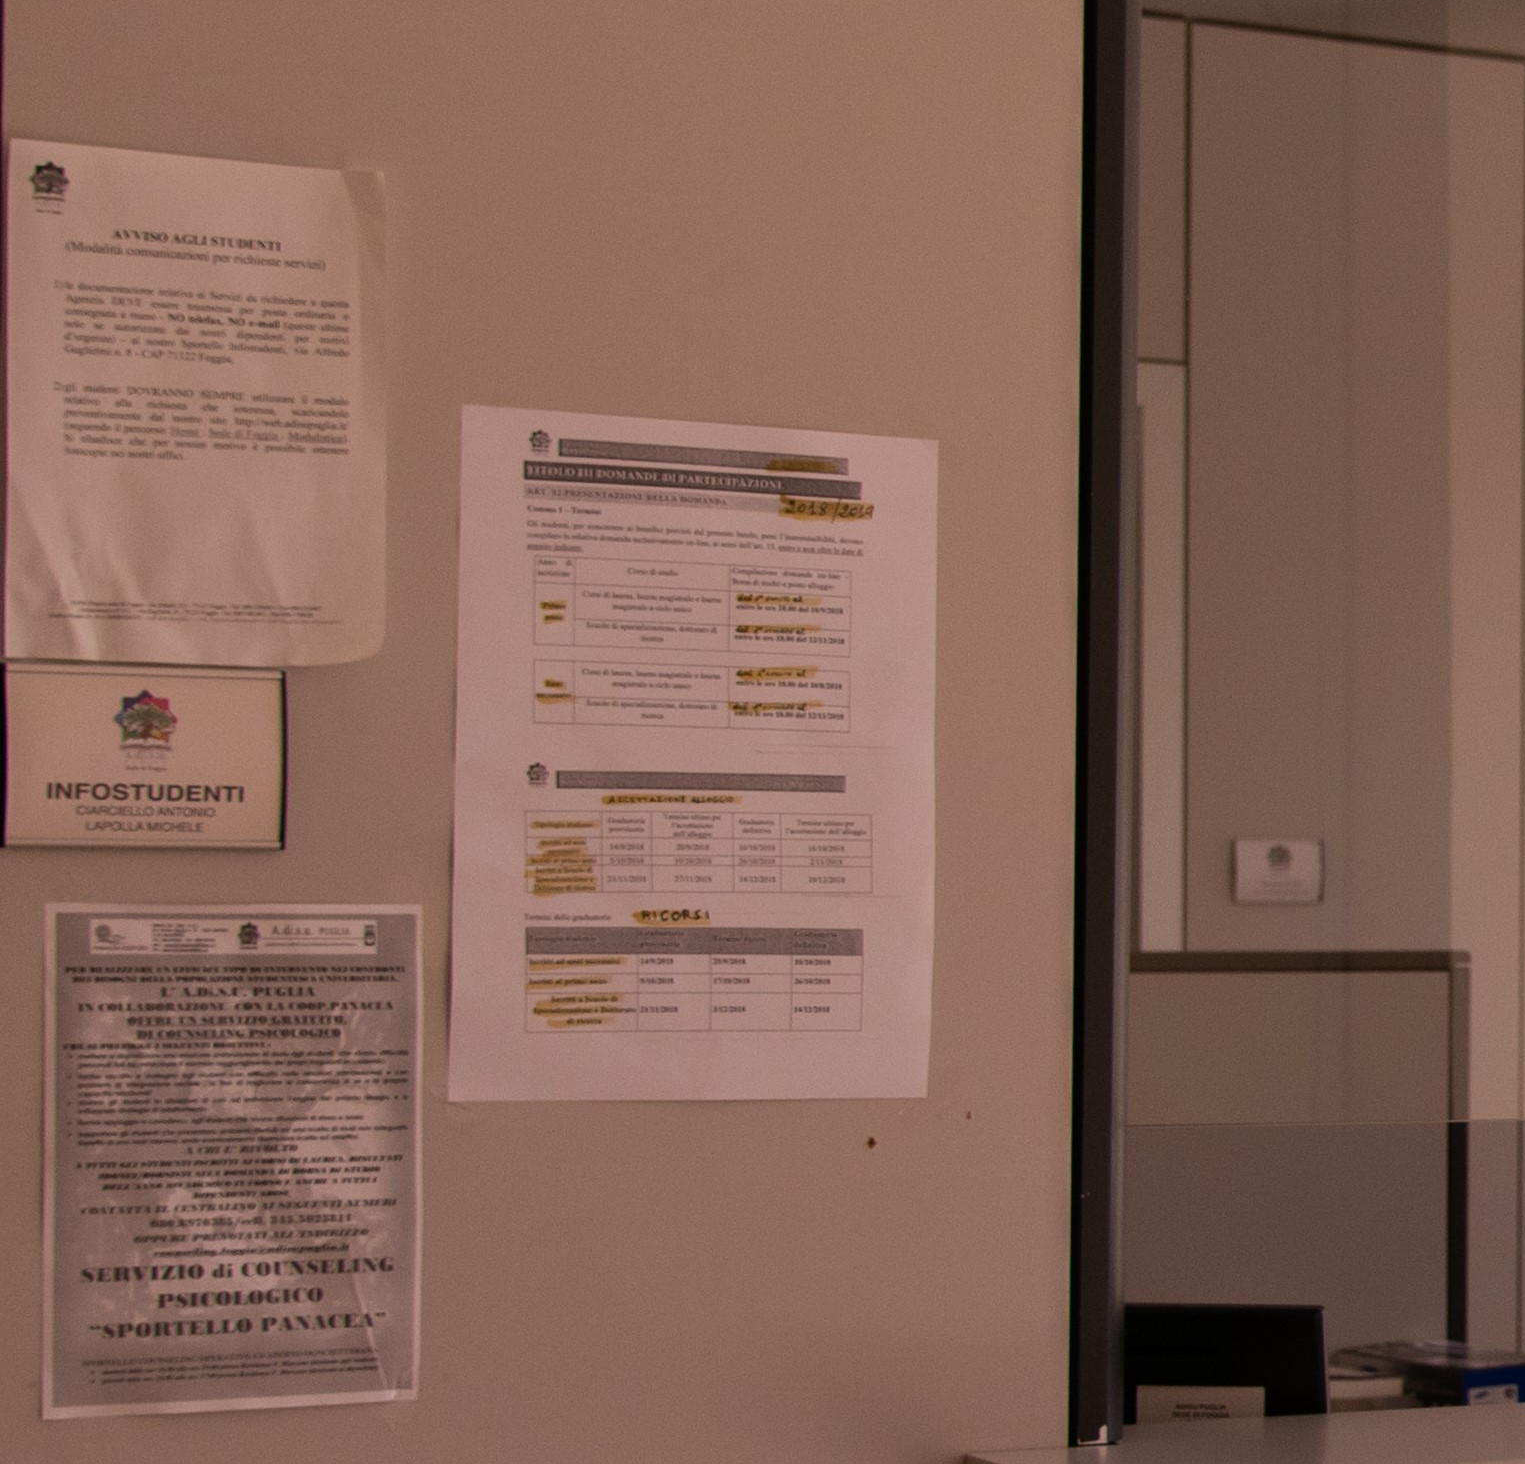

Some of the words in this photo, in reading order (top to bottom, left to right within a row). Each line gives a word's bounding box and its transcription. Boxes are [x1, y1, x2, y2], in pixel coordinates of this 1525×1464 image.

[172, 233, 208, 246] AGLI
[210, 237, 281, 252] STUDENTI
[46, 782, 245, 803] INFOSTUDENTI
[157, 806, 216, 819] ANTONIO
[641, 908, 710, 922] RICORSI
[80, 1264, 204, 1283] SERVIZIO
[213, 1263, 233, 1279] di
[241, 1257, 394, 1278] COUNSELING
[158, 1287, 324, 1309] PSICOLOGICO
